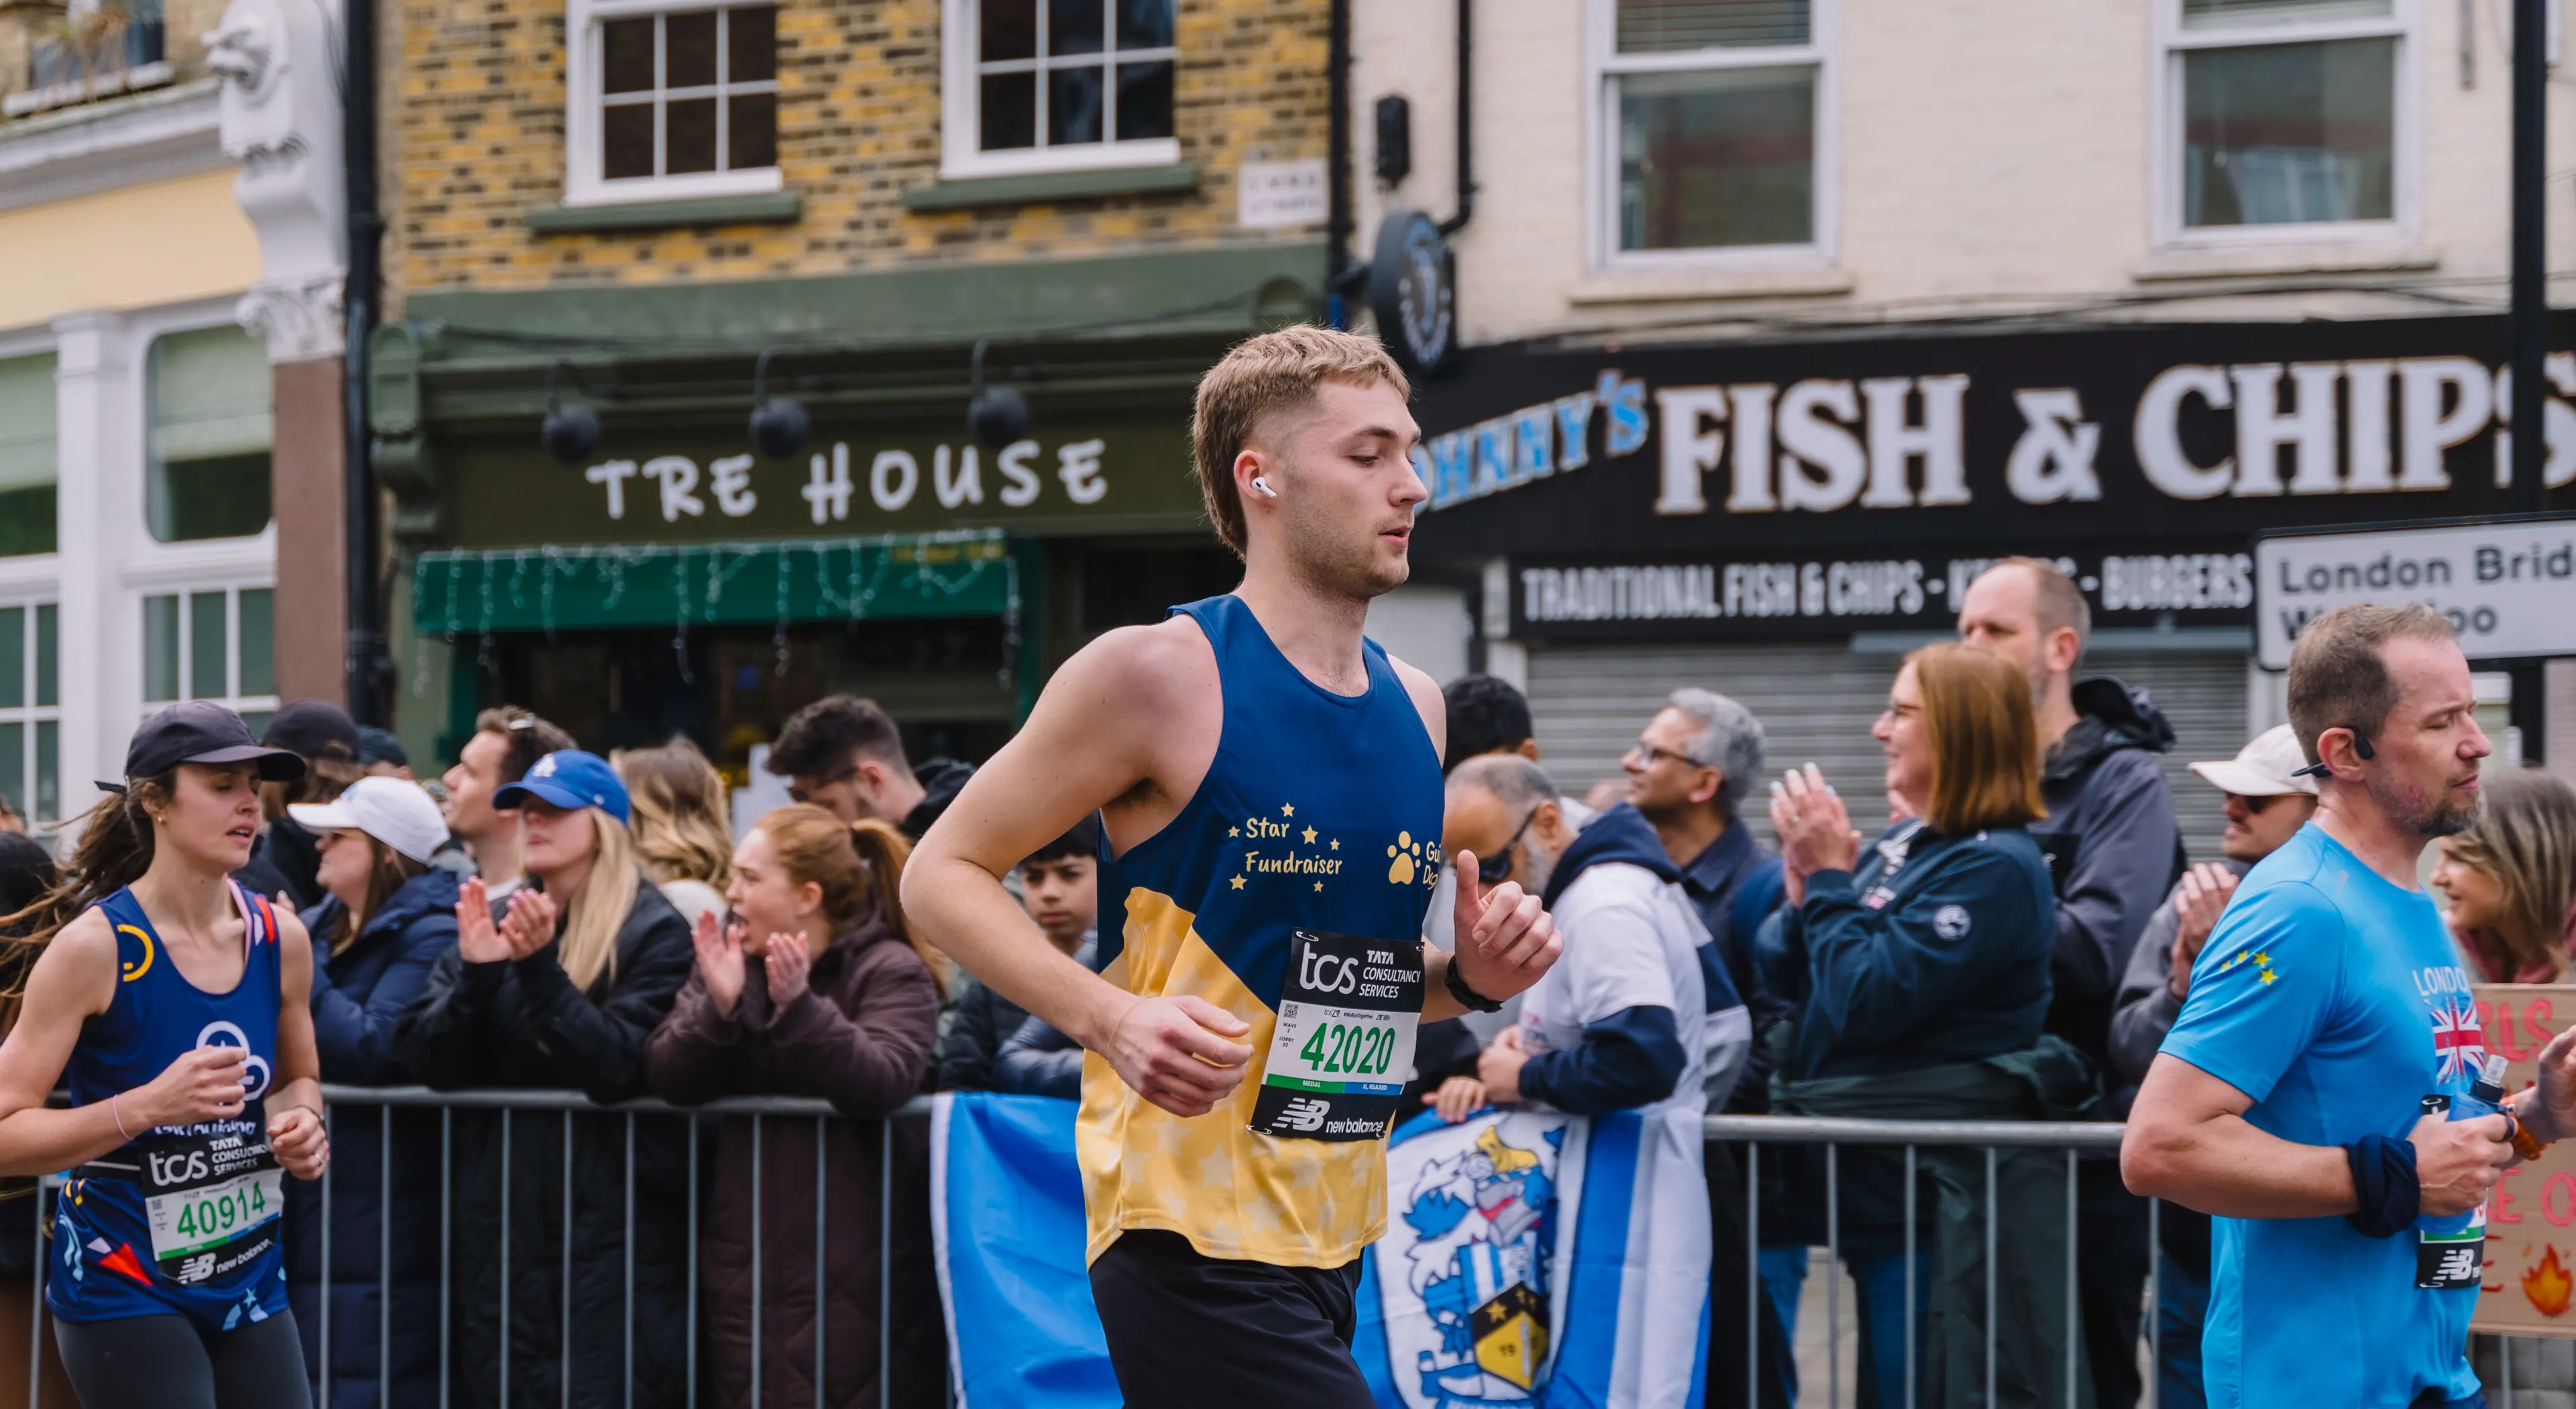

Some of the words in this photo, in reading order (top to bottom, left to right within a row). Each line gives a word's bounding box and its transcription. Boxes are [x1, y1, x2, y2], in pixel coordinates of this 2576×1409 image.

[1654, 372, 1974, 516] FISH
[2004, 386, 2103, 505] &
[584, 454, 757, 522] TRE
[801, 441, 1109, 525] HOUSE
[2279, 550, 2453, 593] London
[1520, 565, 1722, 621] TRADITIONAL
[1724, 562, 1796, 617] FISH
[1800, 562, 1825, 616] &
[1827, 559, 1924, 615] CHIPS
[2101, 553, 2253, 611] BURGERS
[1246, 817, 1290, 839] Star
[1245, 850, 1342, 875] Fundraiser
[1299, 942, 1358, 994] tcs
[1366, 949, 1394, 961] TATA
[1362, 967, 1421, 984] CONSULTANCY
[1358, 984, 1399, 998] SERVICES
[1299, 1023, 1395, 1075] 42020
[1326, 1120, 1346, 1134] new
[1346, 1118, 1384, 1133] balance
[209, 1137, 243, 1151] TATA
[149, 1151, 209, 1186] tcs
[177, 1180, 266, 1239] 40914
[216, 1257, 237, 1273] new
